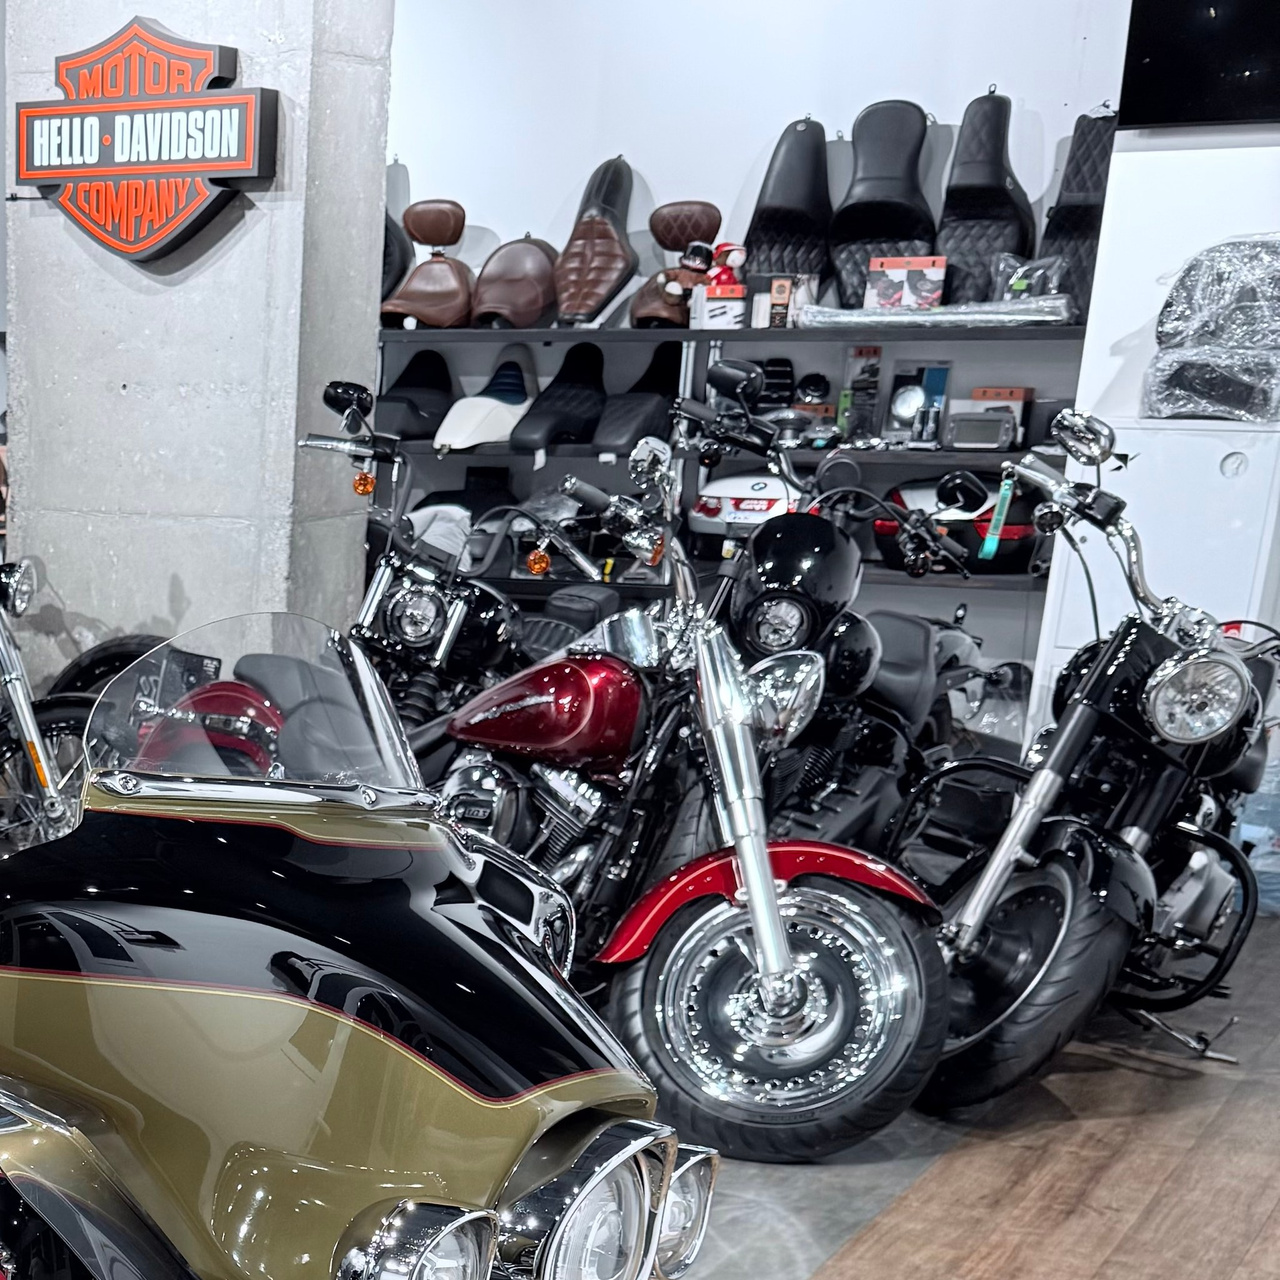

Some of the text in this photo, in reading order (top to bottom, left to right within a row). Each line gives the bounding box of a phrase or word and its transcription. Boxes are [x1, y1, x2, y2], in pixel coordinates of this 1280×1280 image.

[78, 40, 193, 99] MOTOR
[33, 108, 239, 167] HELLO DAVIDSON
[76, 177, 192, 242] COMPANY
